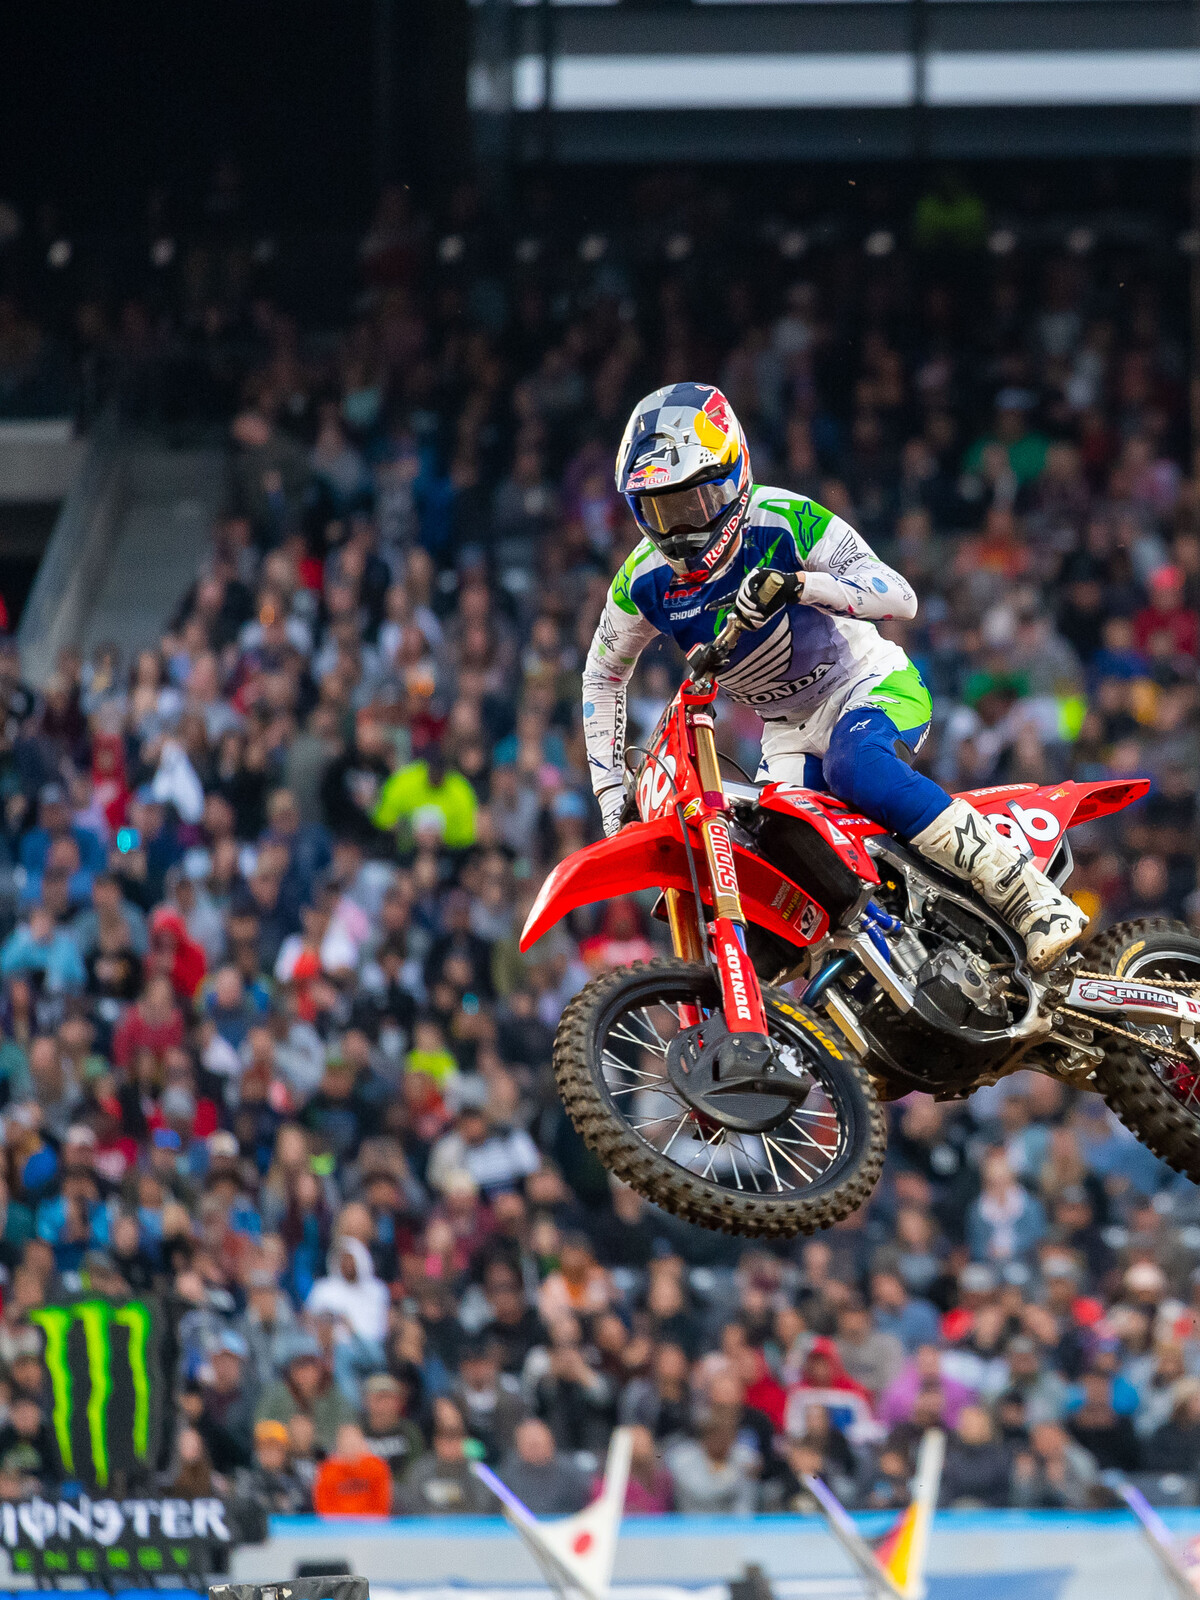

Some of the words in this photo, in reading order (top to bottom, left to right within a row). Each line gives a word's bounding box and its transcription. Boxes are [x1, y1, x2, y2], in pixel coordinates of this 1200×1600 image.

[626, 478, 646, 490] Red
[648, 475, 671, 485] Bull
[702, 526, 731, 569] Red
[670, 606, 702, 620] SHOWA
[728, 661, 837, 705] HONDA
[967, 783, 1034, 797] HONDA
[983, 799, 1061, 861] 96
[709, 823, 738, 892] SHOWA
[724, 943, 752, 1020] DUNLOP
[1079, 981, 1179, 1007] RENTHAL
